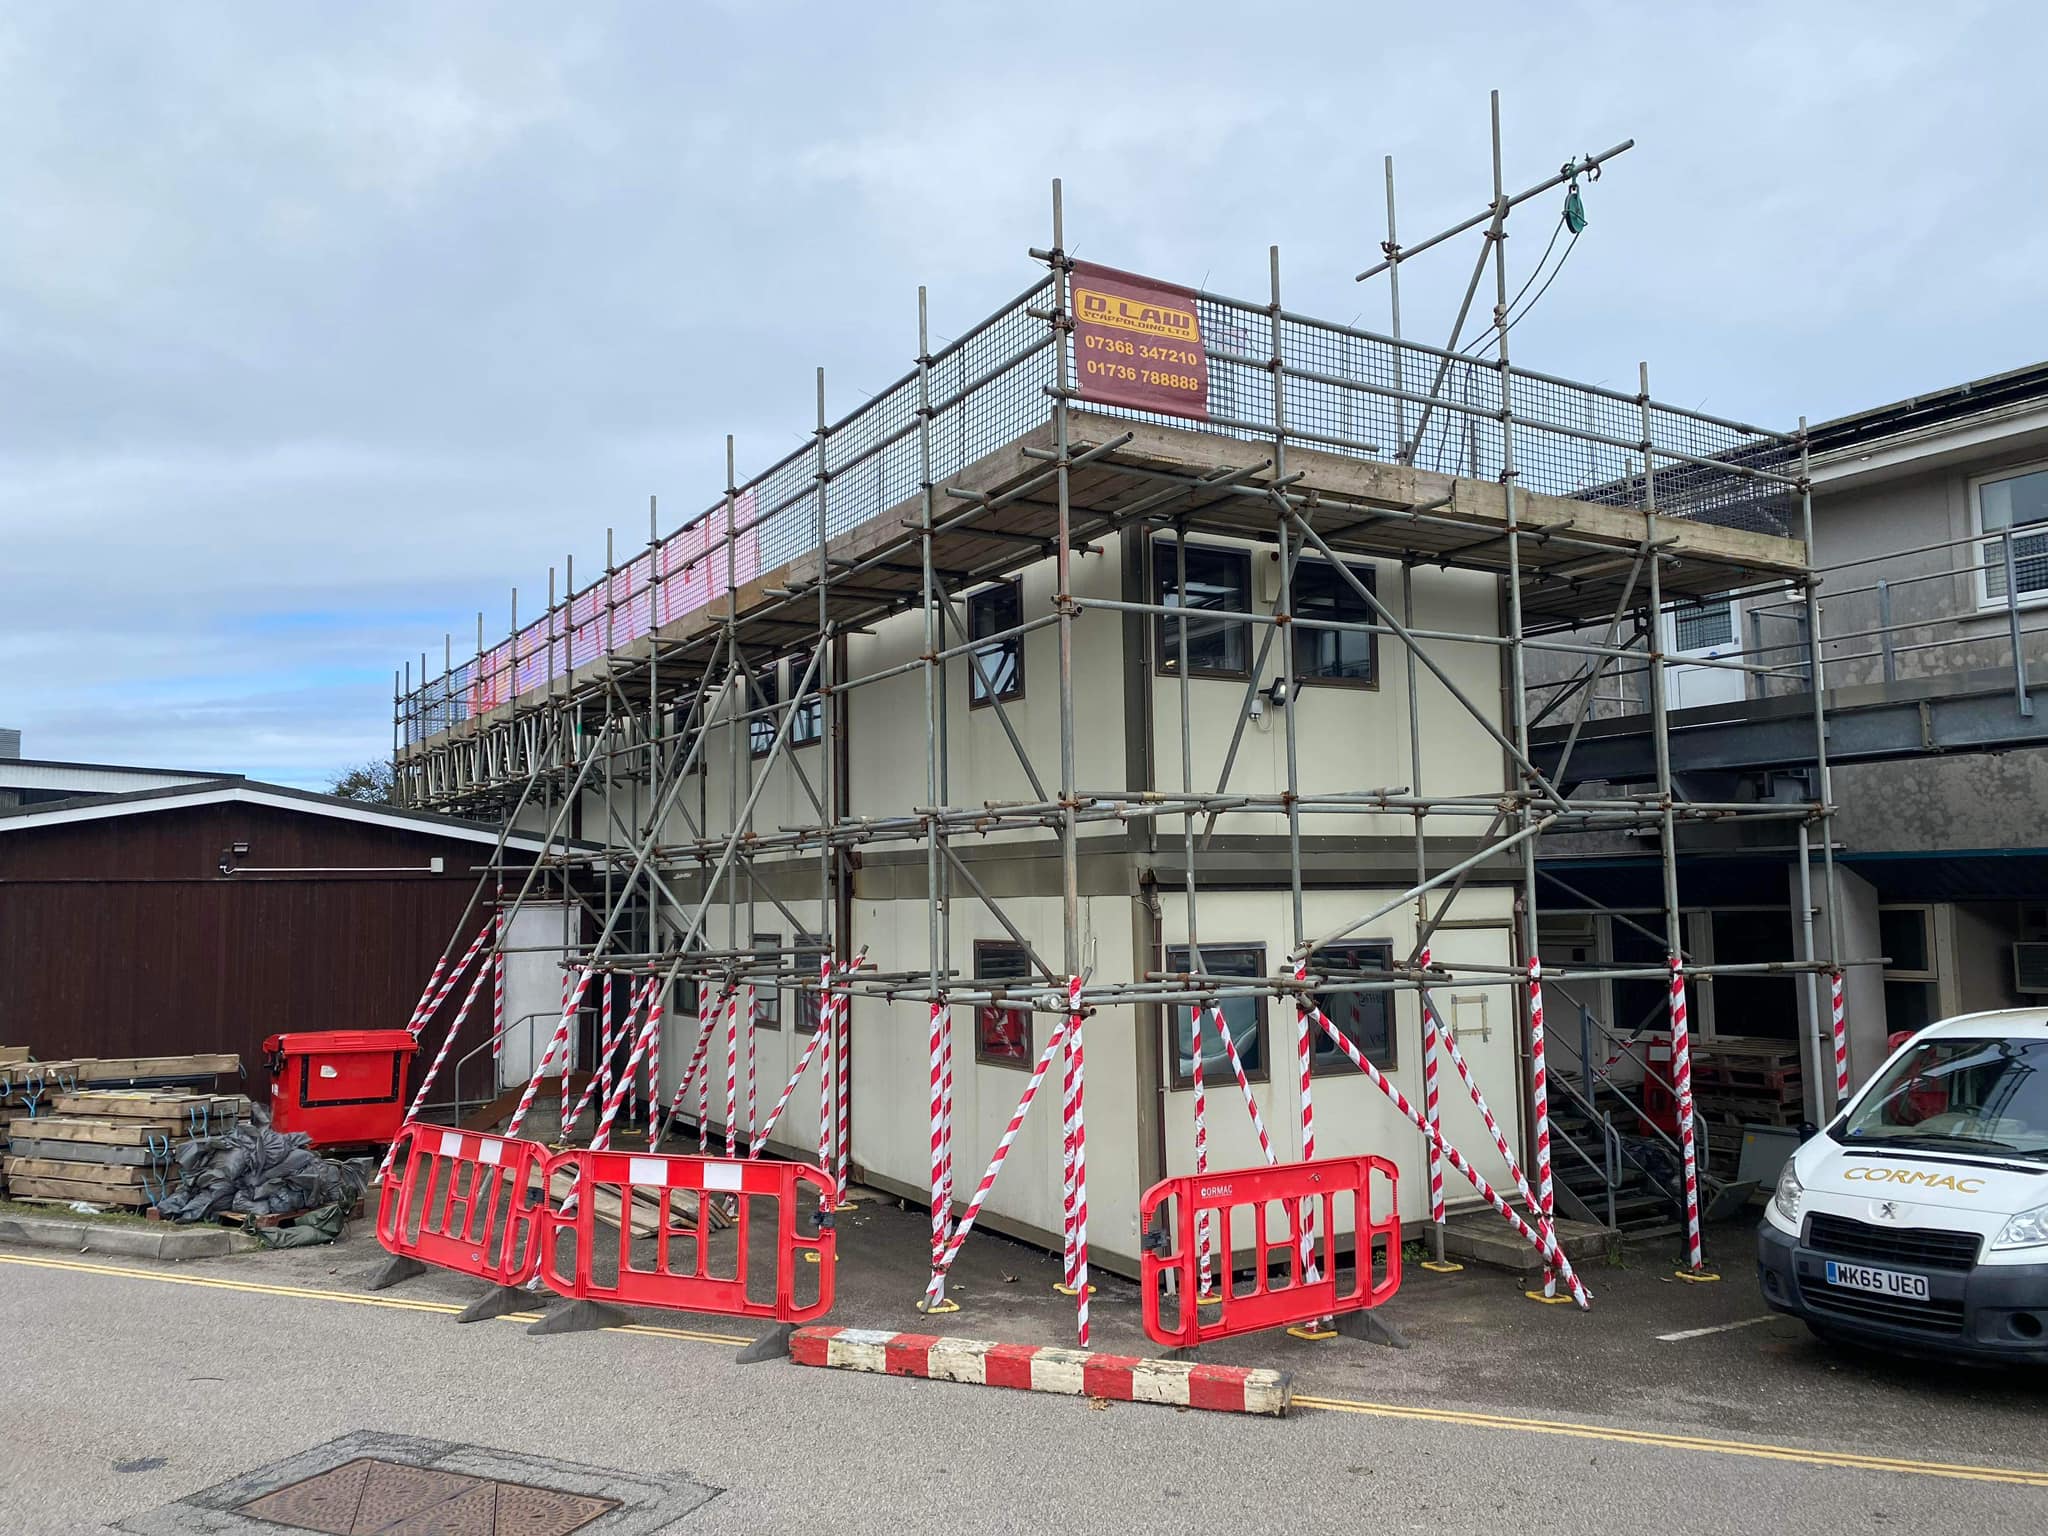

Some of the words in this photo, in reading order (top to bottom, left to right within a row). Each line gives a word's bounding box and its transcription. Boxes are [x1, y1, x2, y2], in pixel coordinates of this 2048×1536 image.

[1083, 294, 1112, 315] D.
[1119, 302, 1191, 330] LAW
[1167, 327, 1191, 337] LTD
[1084, 335, 1135, 356] 07368
[1139, 345, 1198, 366] 347210
[1086, 360, 1137, 381] 01736
[1140, 369, 1199, 391] 788888
[1200, 1184, 1233, 1197] CORMAC
[1843, 1167, 1986, 1194] CORMAC
[1837, 1265, 1883, 1289] WK65
[1887, 1273, 1926, 1297] UEO
